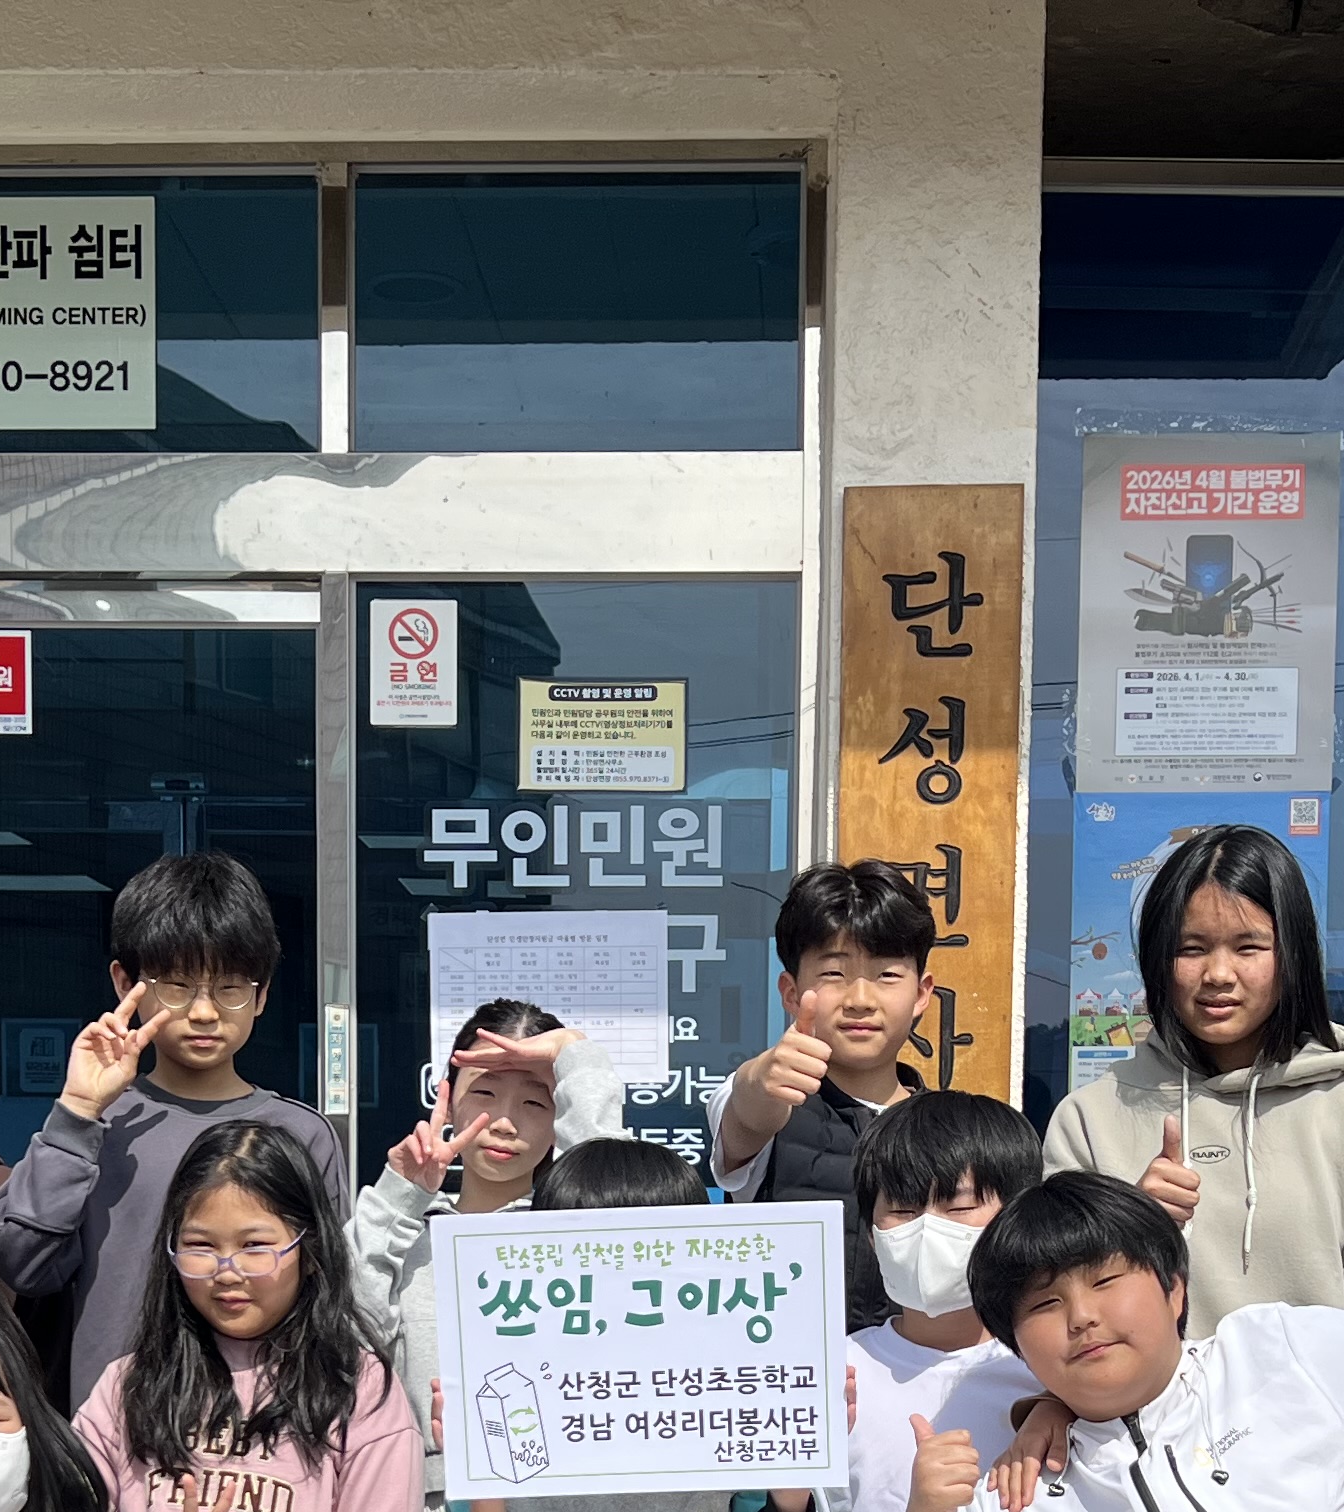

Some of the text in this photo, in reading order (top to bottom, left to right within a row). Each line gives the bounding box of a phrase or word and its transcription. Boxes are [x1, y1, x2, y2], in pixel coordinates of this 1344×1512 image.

[68, 223, 142, 279] 쉼터
[52, 304, 147, 327] CENTER)
[1126, 468, 1301, 490] 2026년 4월 불법무기
[1125, 493, 1300, 515] 자진신고 기간 운영
[553, 689, 580, 698] CCTV
[424, 804, 724, 889] 무인민원
[496, 1233, 776, 1273] 탄소중립 실천을 위한 자원순환
[558, 1365, 818, 1401] 산청군 단성초등학교
[561, 1406, 819, 1442] 경남 여성리더봉사단
[714, 1439, 820, 1463] 산청군지부
